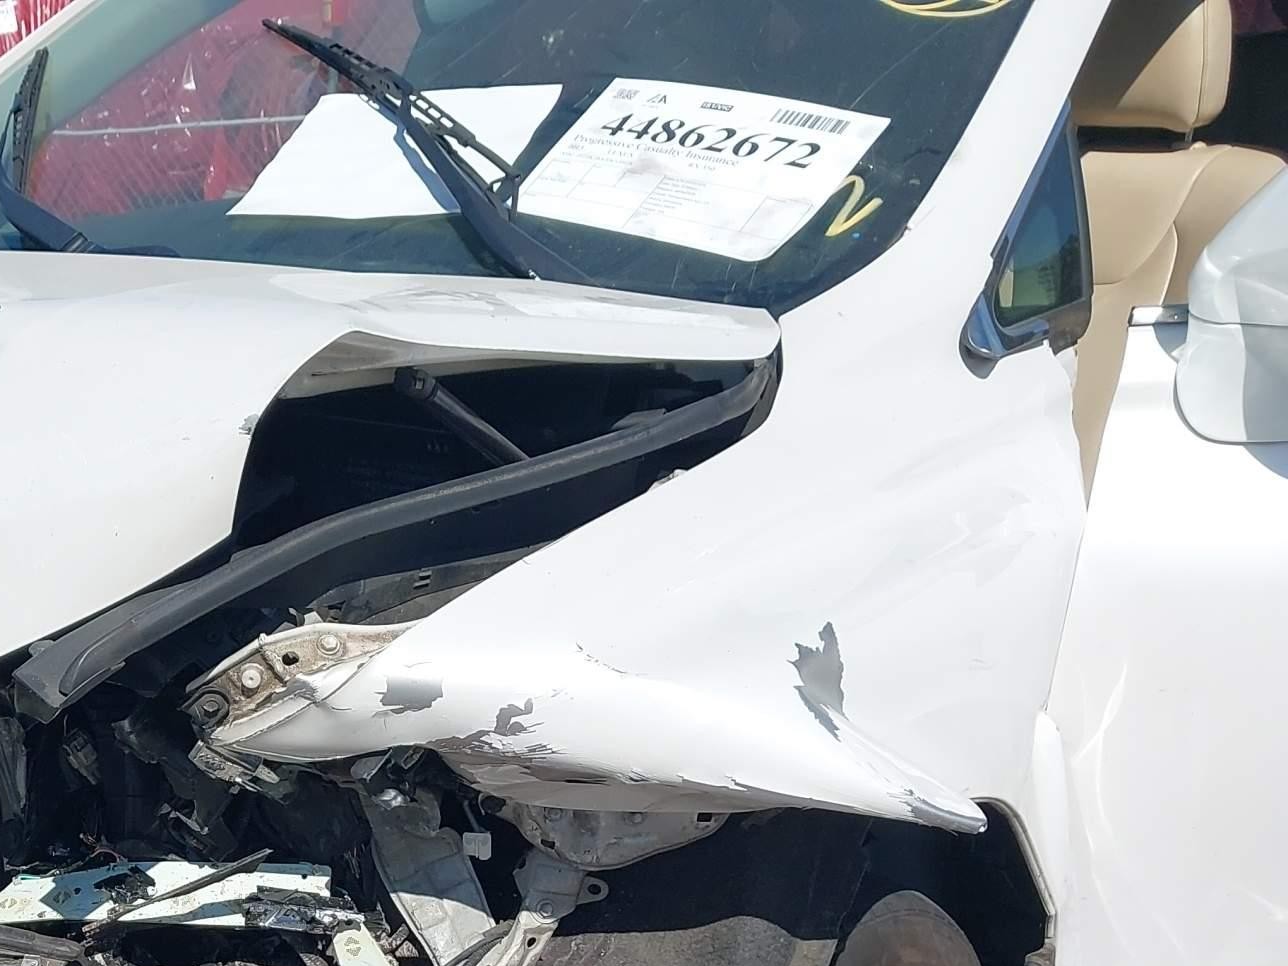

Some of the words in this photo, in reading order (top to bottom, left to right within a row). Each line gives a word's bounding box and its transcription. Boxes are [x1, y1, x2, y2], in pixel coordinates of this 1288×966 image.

[574, 134, 634, 149] Progressive
[636, 143, 683, 159] Casualty
[685, 150, 740, 167] Insurance
[601, 113, 821, 169] 44862672
